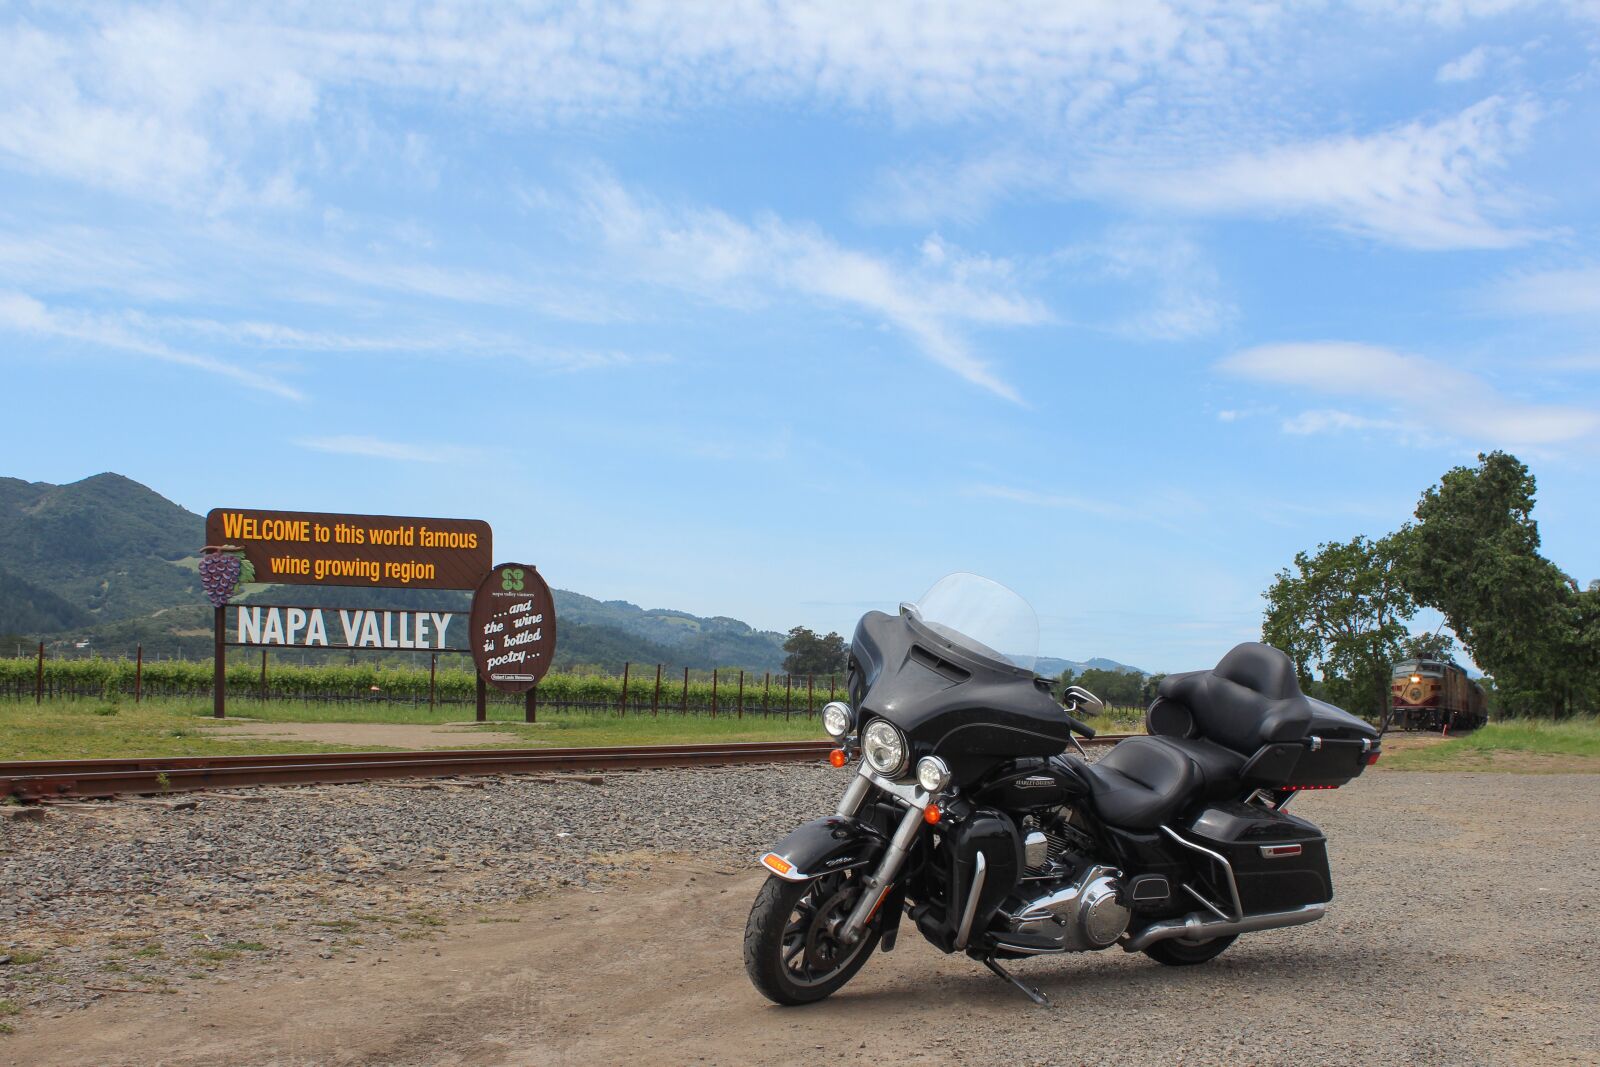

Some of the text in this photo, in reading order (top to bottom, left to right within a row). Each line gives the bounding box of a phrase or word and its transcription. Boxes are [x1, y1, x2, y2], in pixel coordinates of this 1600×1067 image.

[223, 513, 478, 549] WELCOME to this world famous
[271, 555, 435, 583] wine growing region
[238, 606, 453, 649] NAPA VALLEY
[484, 613, 542, 634] the wine
[483, 627, 542, 652] is bottled
